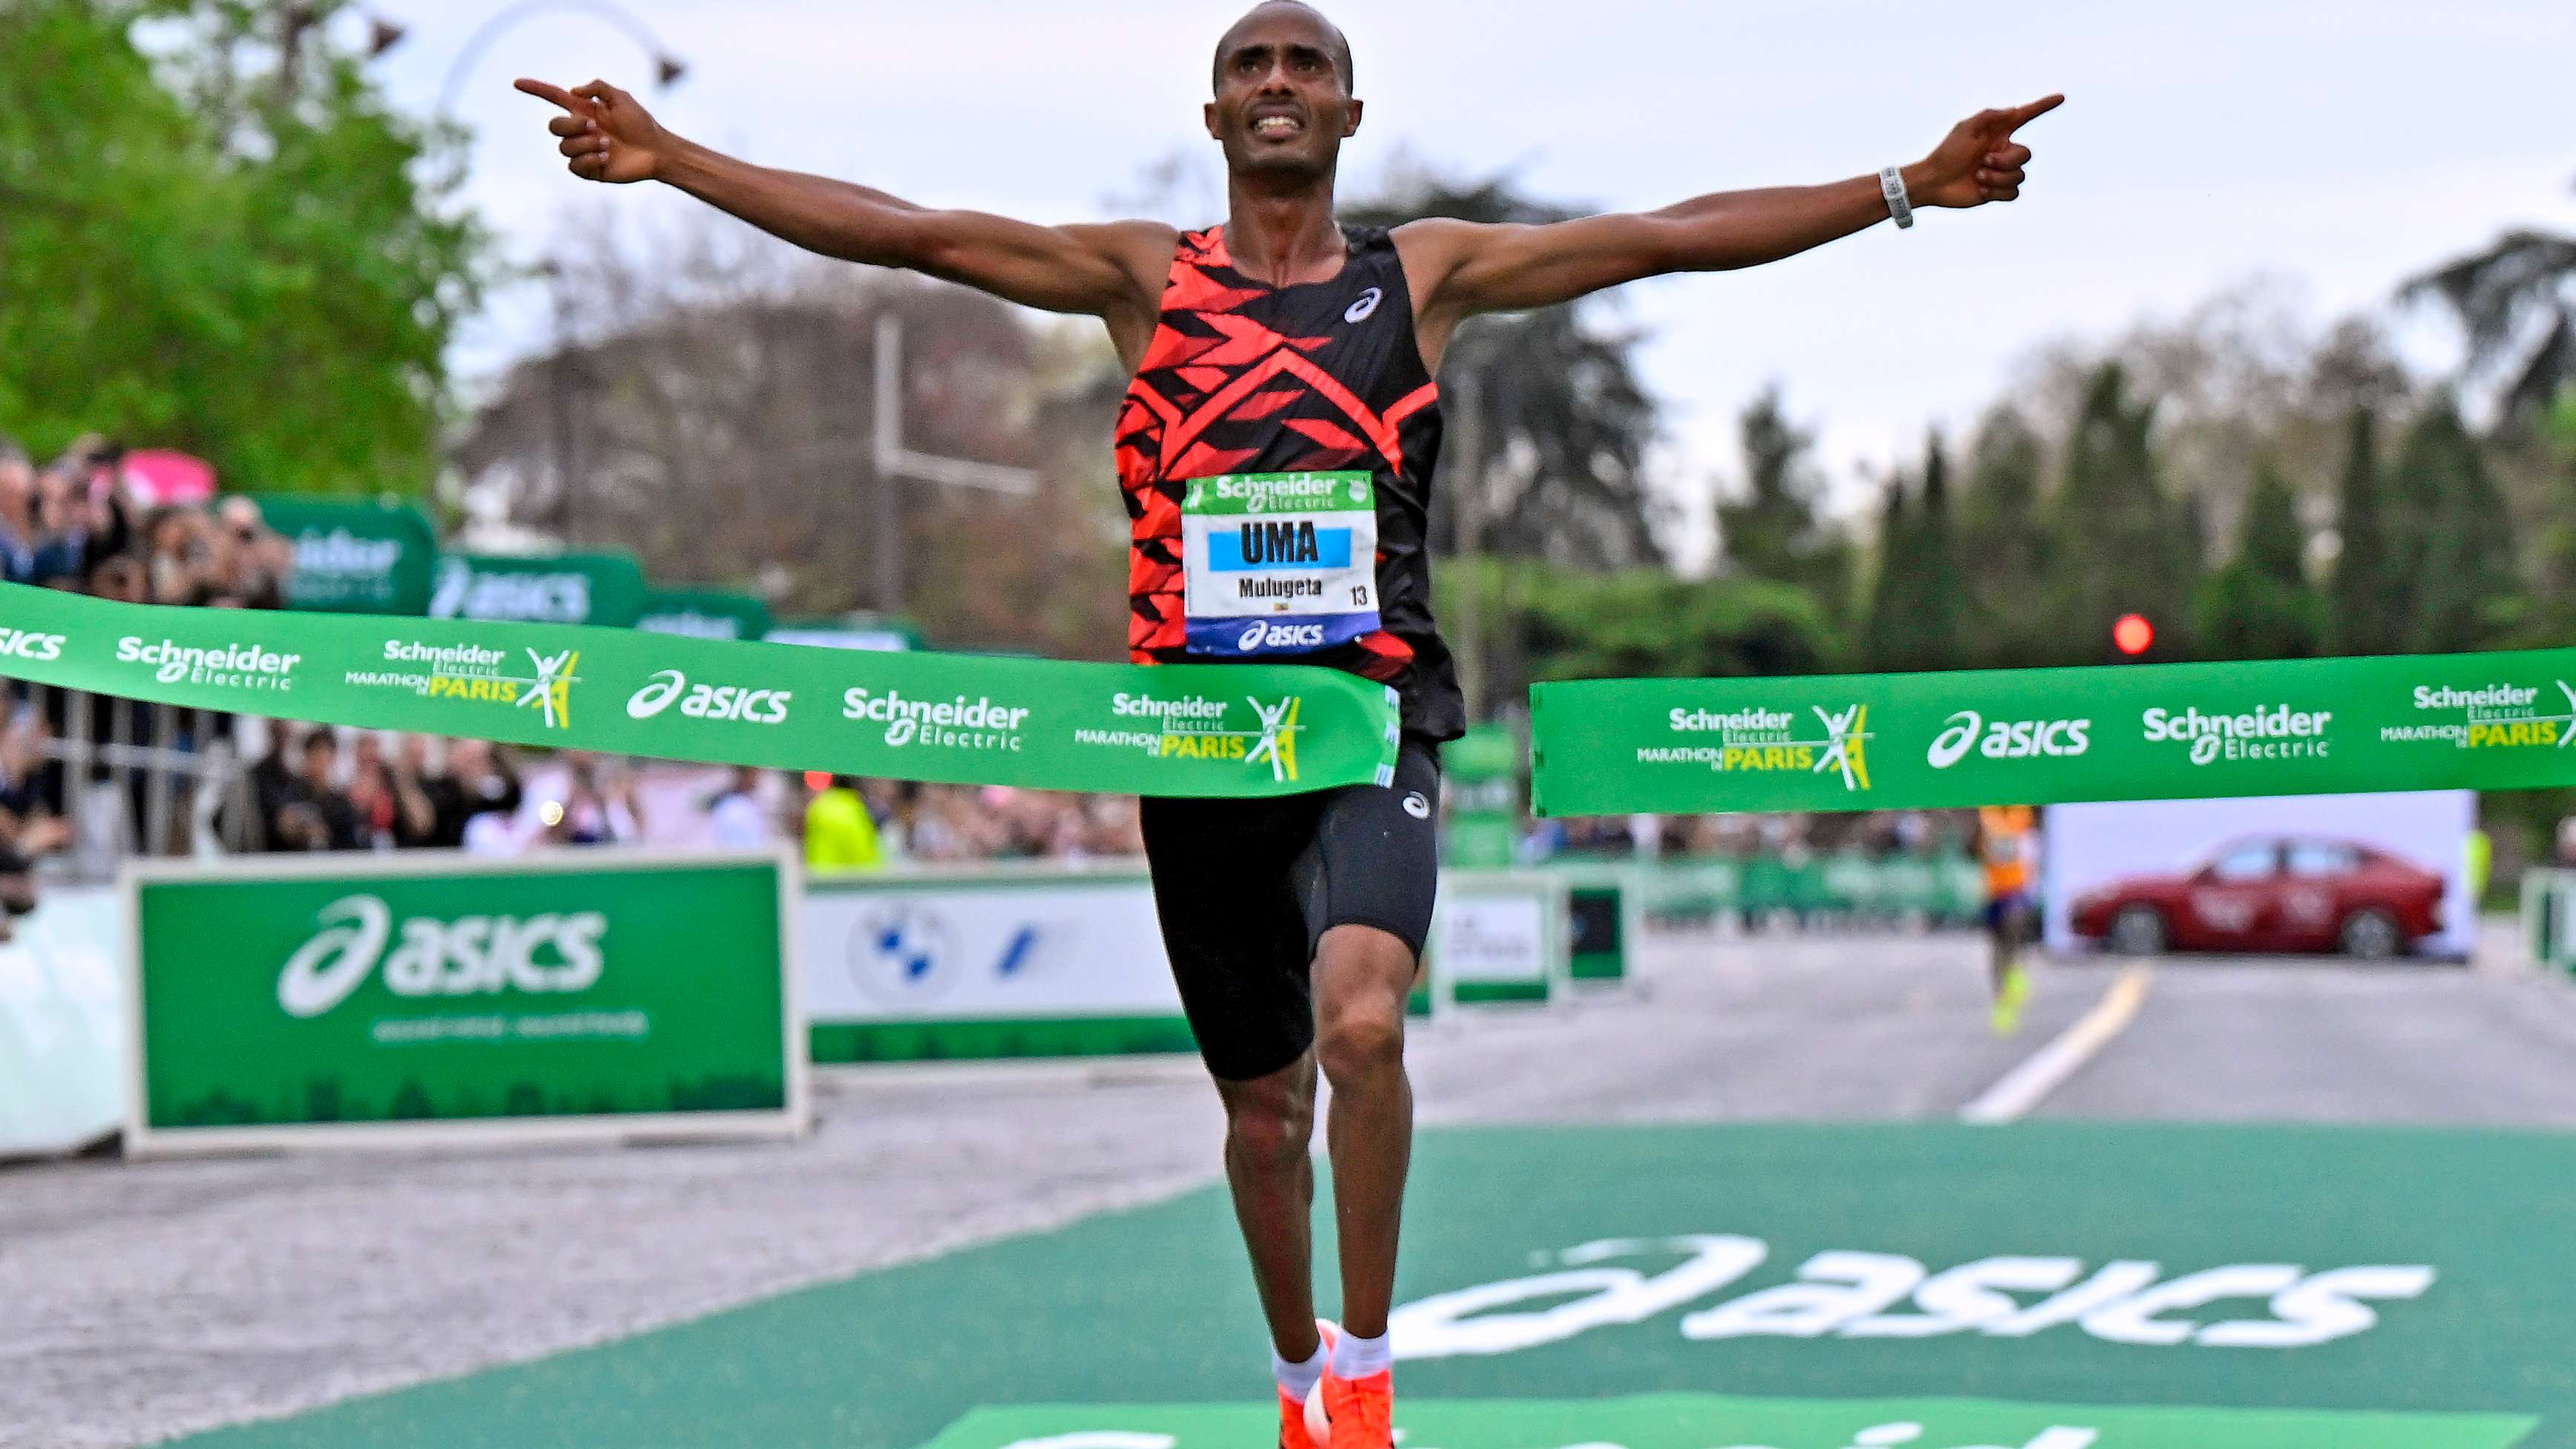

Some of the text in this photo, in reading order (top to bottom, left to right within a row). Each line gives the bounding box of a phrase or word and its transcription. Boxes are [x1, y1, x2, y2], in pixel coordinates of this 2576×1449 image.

[1217, 473, 1337, 498] Schneider
[1239, 520, 1318, 565] UMA
[1238, 577, 1321, 598] Mulugeta
[1350, 586, 1367, 606] 13
[116, 635, 301, 673] Schneider
[383, 640, 506, 665] Schneider
[190, 667, 292, 691] Electric
[344, 671, 430, 689] MARATHON
[429, 676, 517, 702] PARIS
[843, 687, 1029, 730] Schneider
[1113, 693, 1228, 718] Schneider
[2413, 683, 2538, 709] Schneider
[1669, 707, 1794, 731] Schneider
[2142, 703, 2332, 741] Schneider
[919, 724, 1022, 750] Electric
[1074, 729, 1161, 748] MARATHON
[1161, 735, 1246, 759] PARIS
[2380, 721, 2558, 748] MARATHON PARIS
[1637, 748, 1722, 762] MARATHON
[1723, 747, 1814, 770] PARIS
[2224, 739, 2329, 760] Electric
